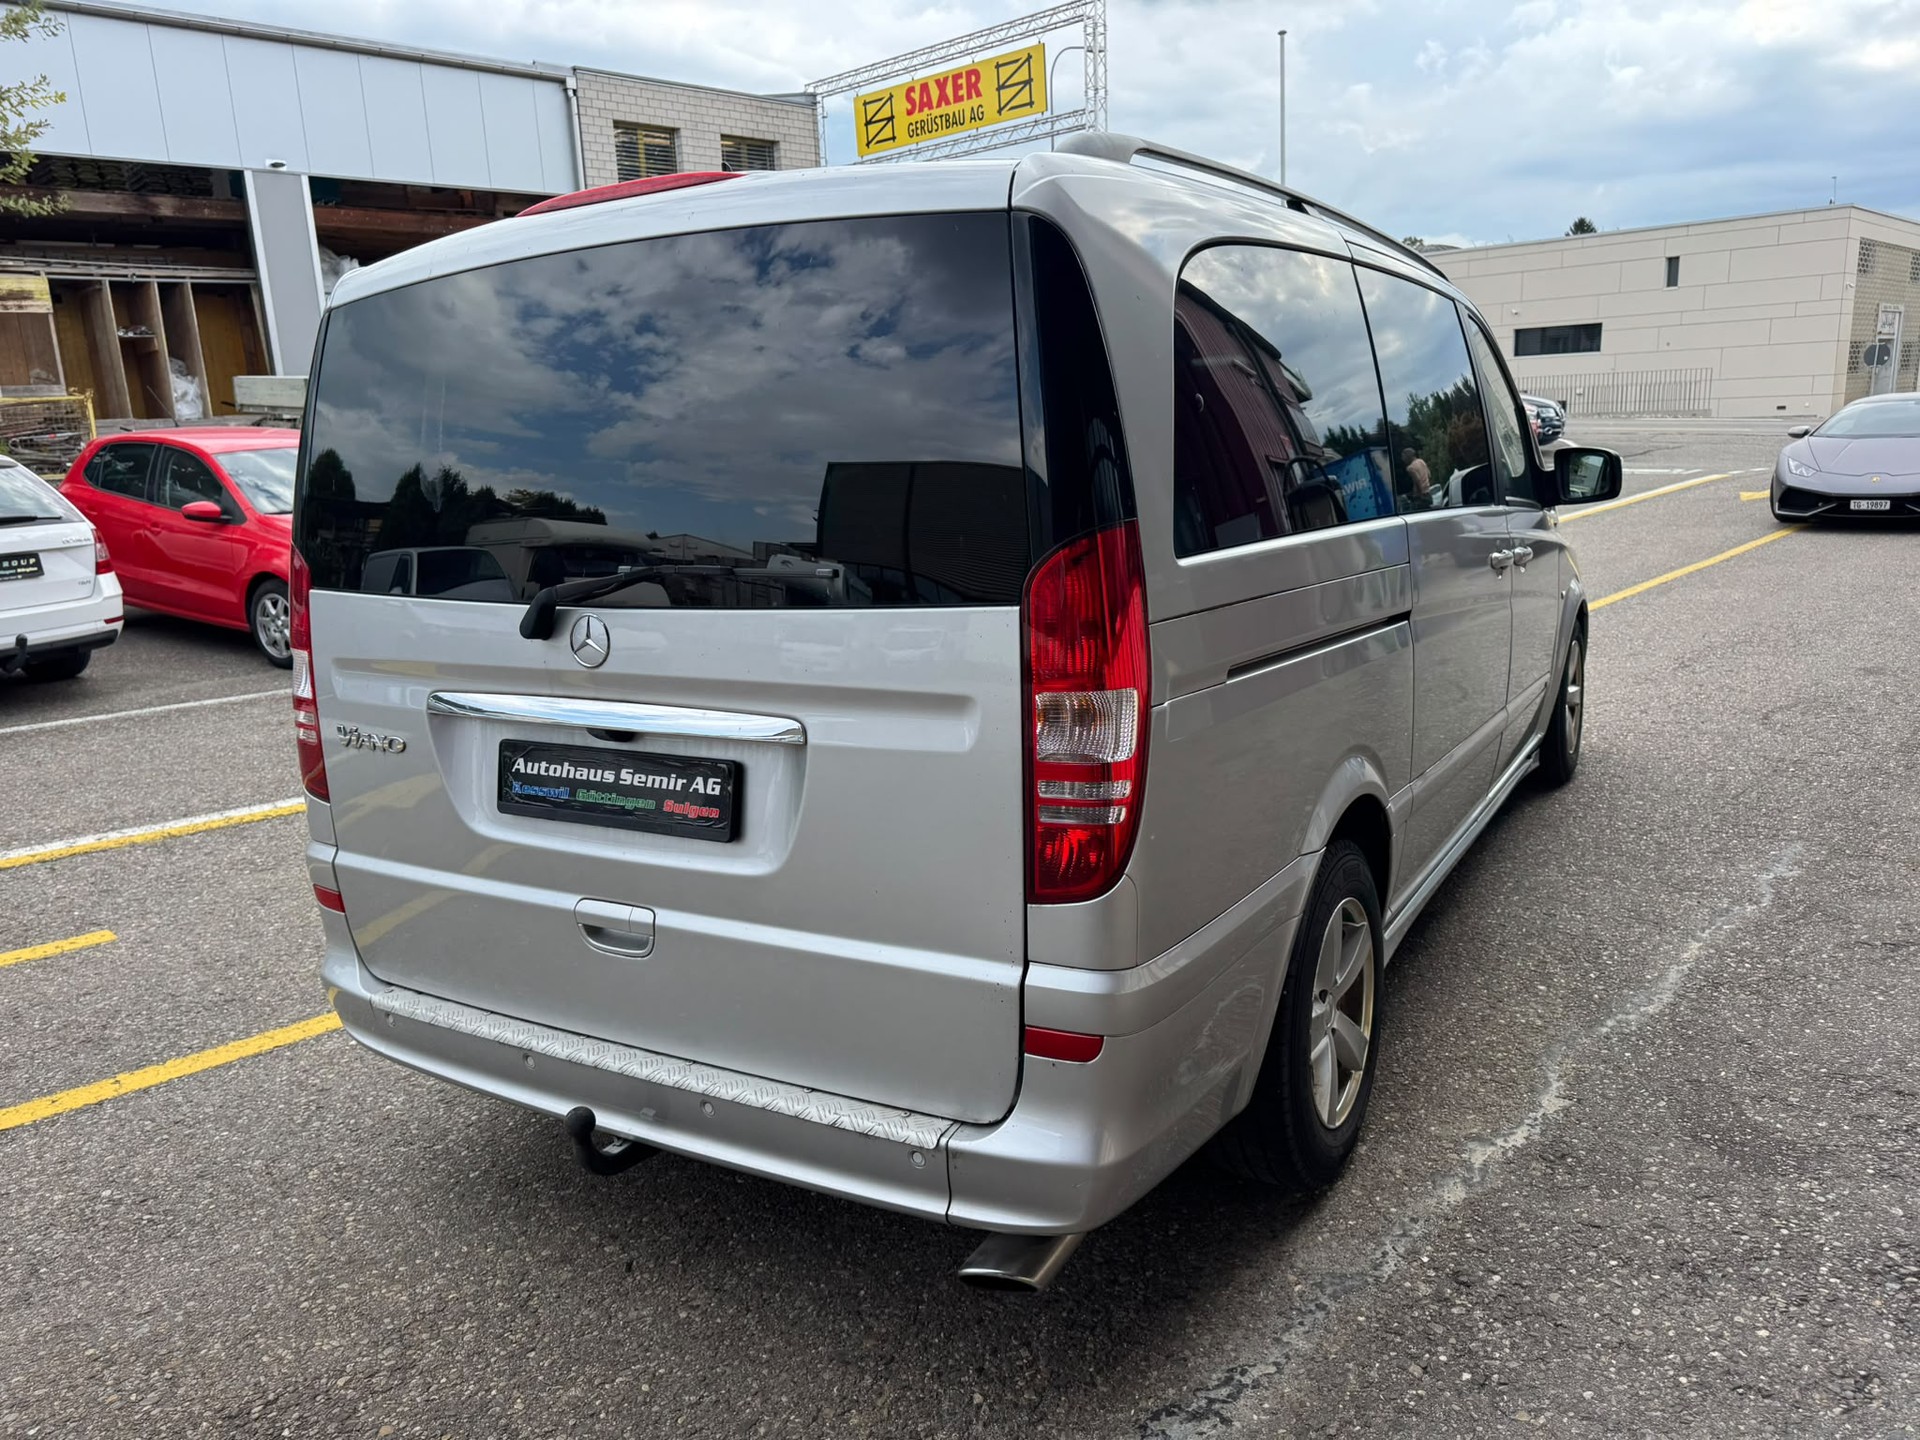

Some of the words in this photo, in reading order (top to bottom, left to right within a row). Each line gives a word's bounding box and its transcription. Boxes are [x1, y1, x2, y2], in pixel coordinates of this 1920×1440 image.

[905, 68, 982, 116] SAXER
[907, 108, 966, 139] GERÜSTBAU
[969, 104, 985, 122] AG
[336, 723, 407, 754] VIANO
[512, 757, 616, 784] Autohaus
[619, 768, 687, 791] Semir
[689, 776, 722, 796] AG
[663, 799, 720, 818] Sulgen
